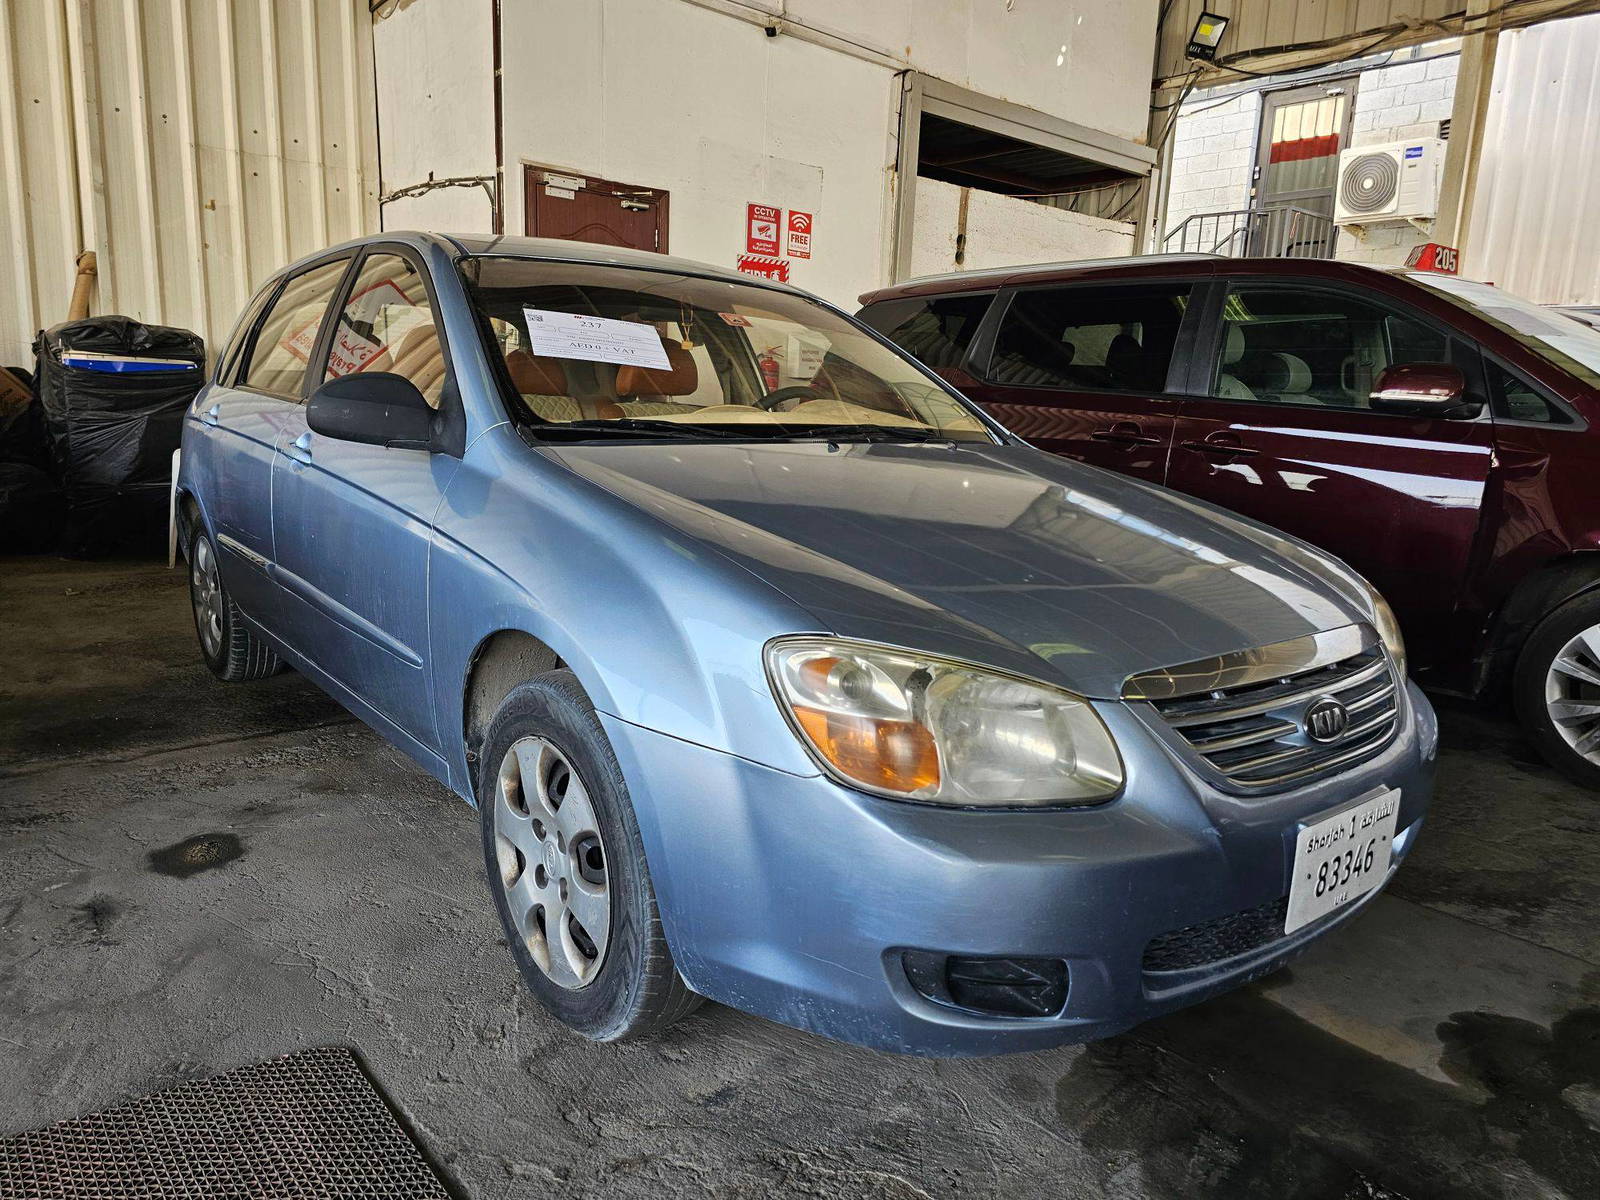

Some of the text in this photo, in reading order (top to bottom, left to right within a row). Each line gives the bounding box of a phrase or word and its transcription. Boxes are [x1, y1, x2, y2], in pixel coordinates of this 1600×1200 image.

[754, 206, 776, 217] CCTV
[790, 233, 809, 245] FREE
[1434, 246, 1457, 272] 205
[579, 320, 602, 329] 237
[613, 347, 637, 355] VAT
[1311, 707, 1343, 737] KIA
[1359, 800, 1395, 829] الشارقة
[1306, 815, 1356, 853] Sharjah 1
[1315, 838, 1376, 898] 83346
